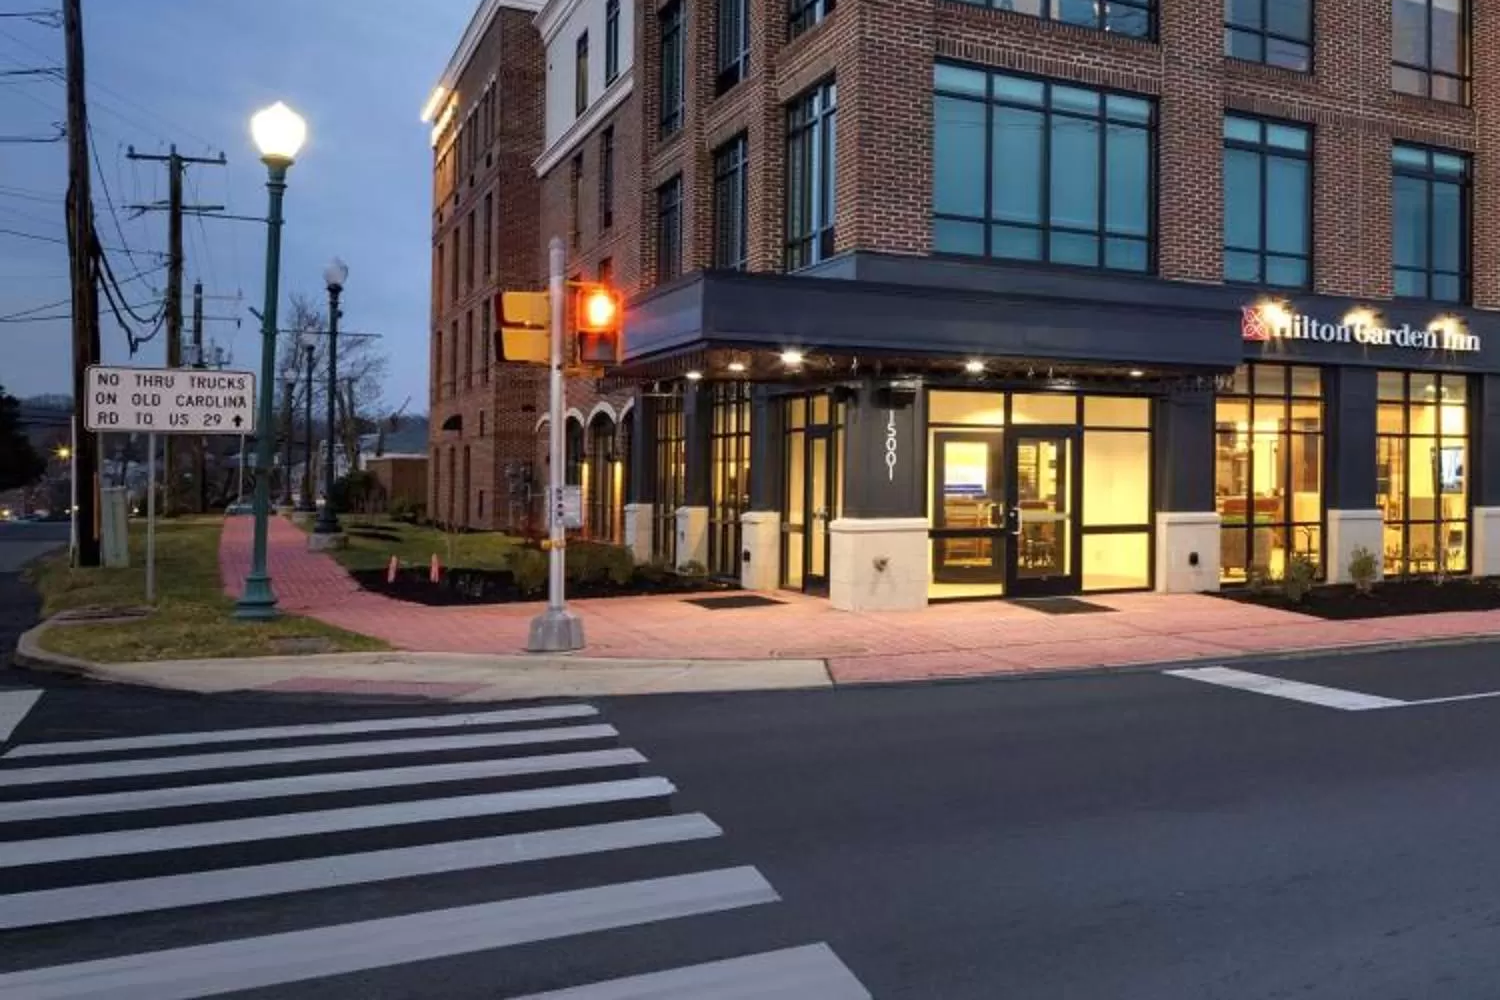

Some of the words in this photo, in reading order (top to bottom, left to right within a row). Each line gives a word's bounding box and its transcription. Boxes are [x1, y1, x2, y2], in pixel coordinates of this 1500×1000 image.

[1274, 314, 1350, 343] Hilton
[1353, 320, 1437, 349] Garden
[1442, 328, 1481, 351] Inn
[97, 373, 120, 387] NO
[135, 374, 175, 389] THRU
[189, 375, 246, 390] TRUCKS
[95, 392, 117, 406] ON
[131, 393, 161, 407] OLD
[175, 394, 247, 409] CAROLINA
[97, 411, 119, 425] RD
[135, 412, 153, 425] TO
[169, 413, 189, 426] US
[203, 413, 222, 427] 29
